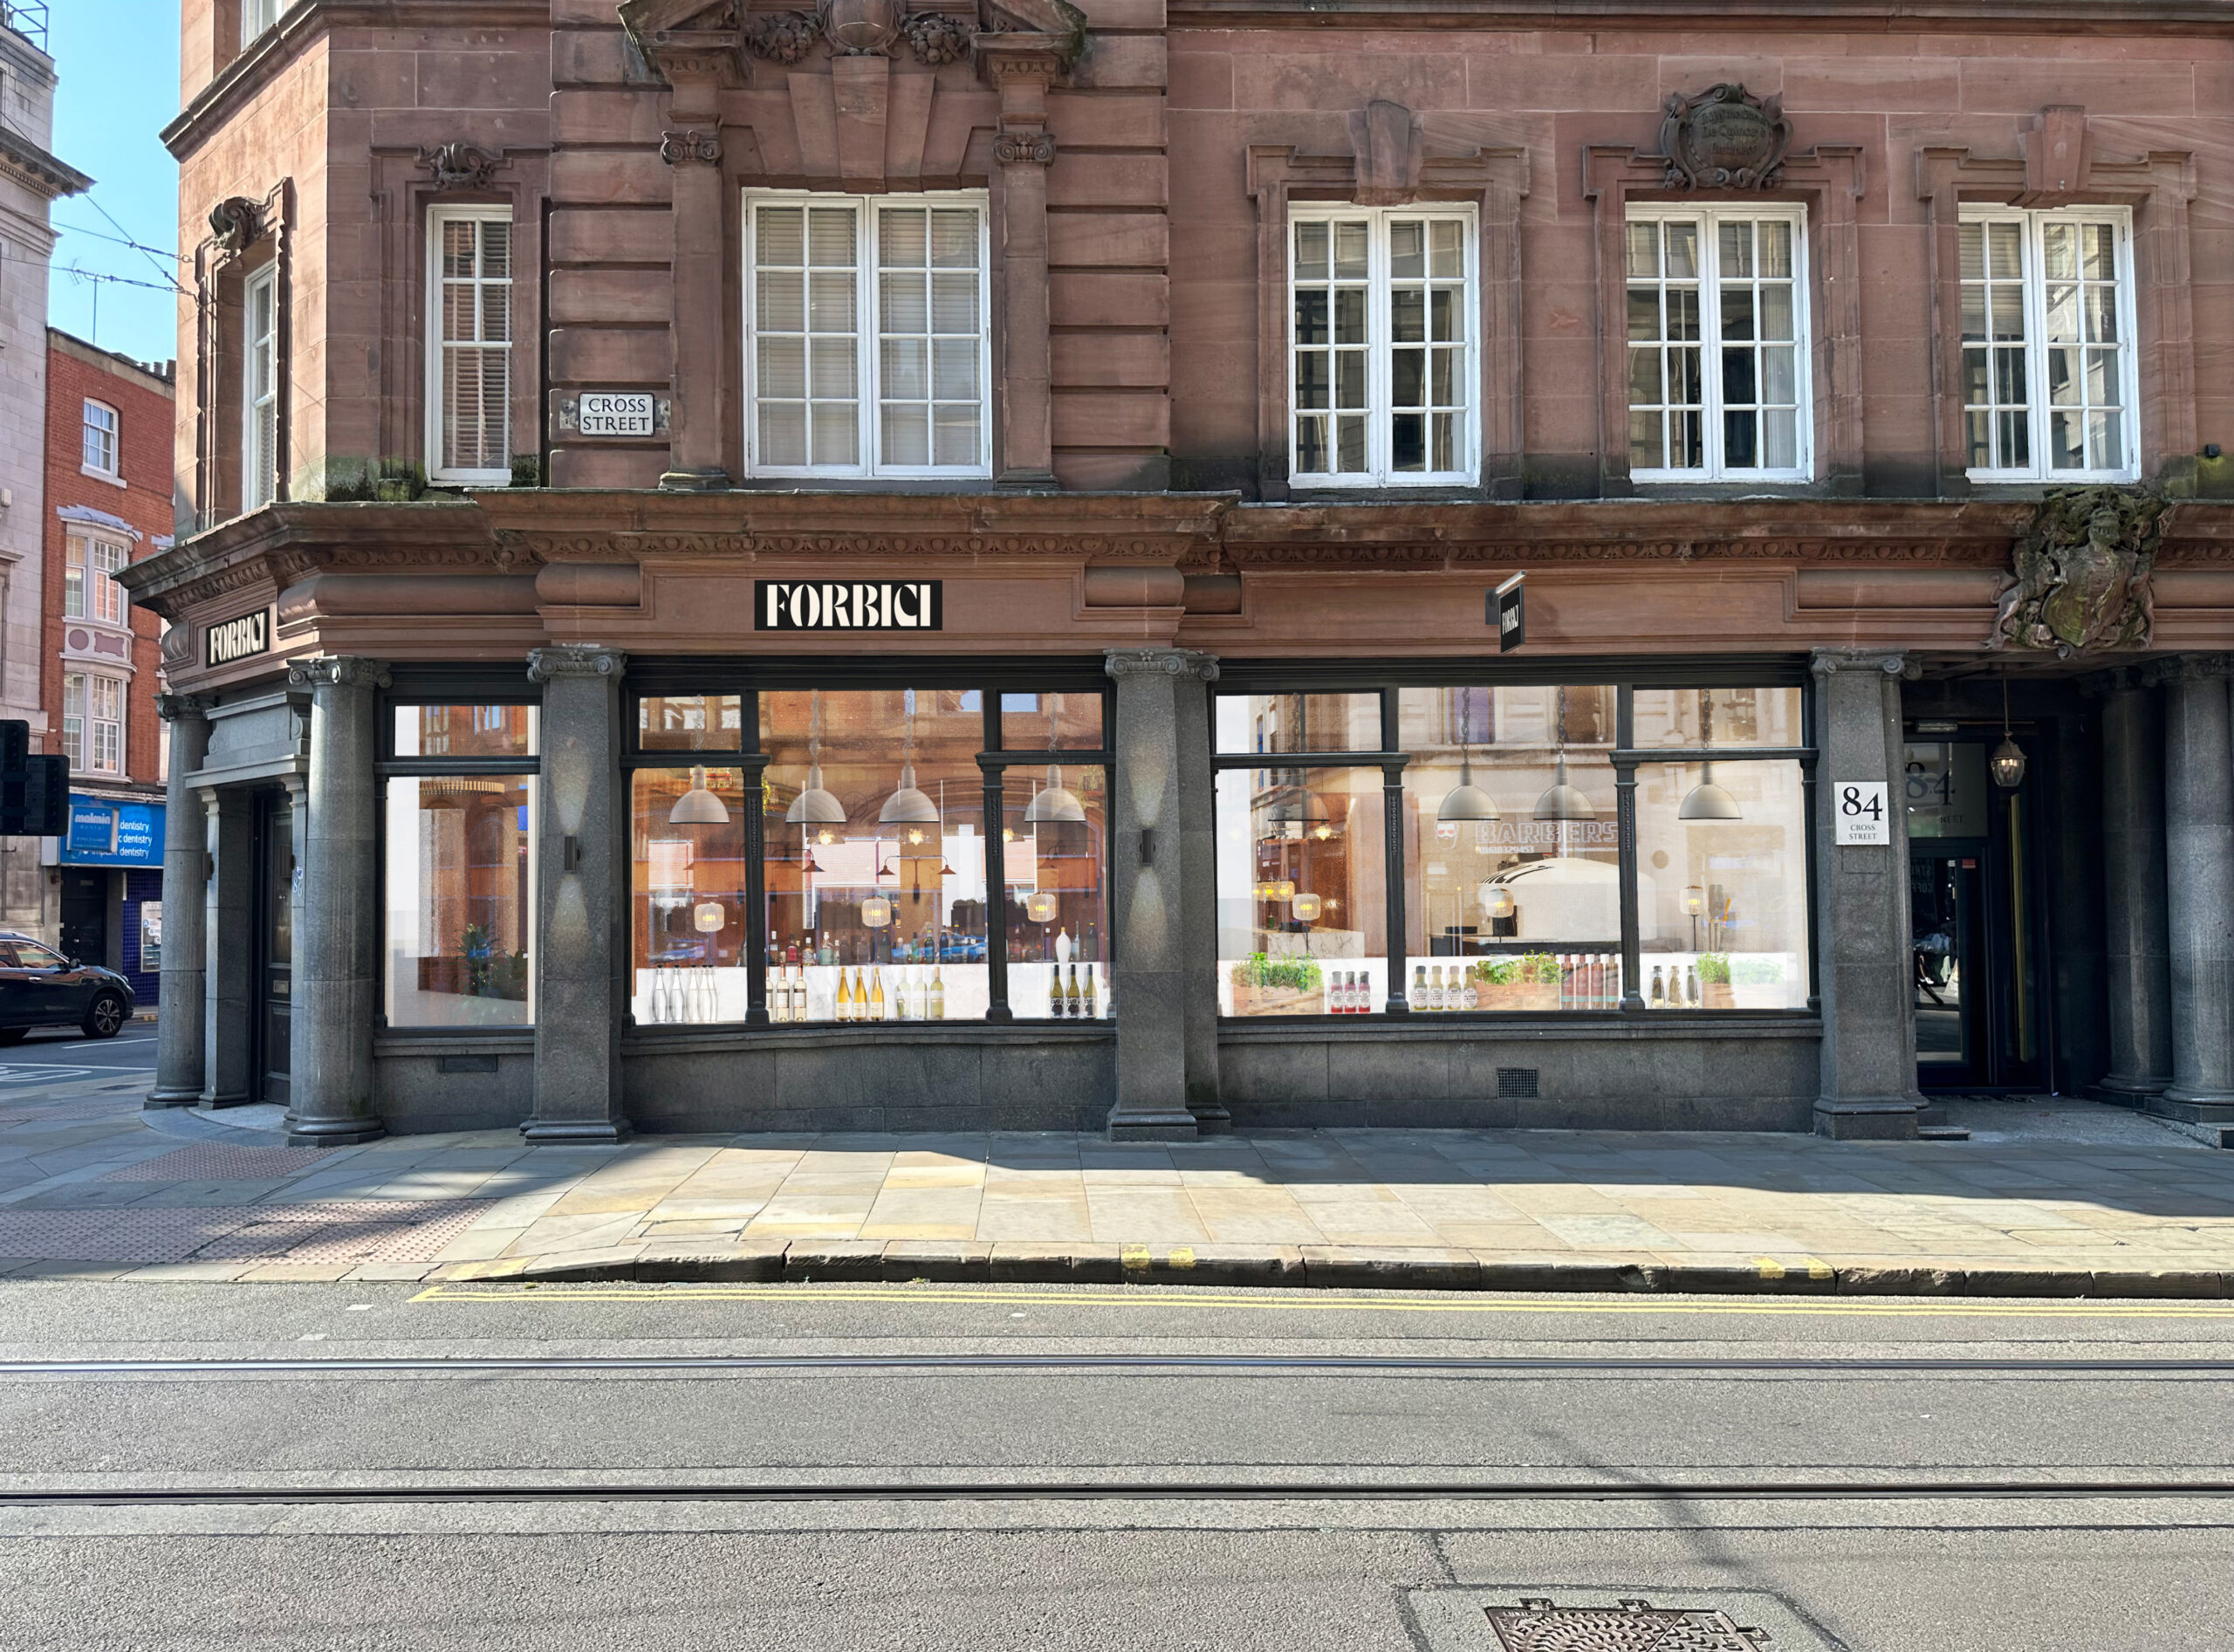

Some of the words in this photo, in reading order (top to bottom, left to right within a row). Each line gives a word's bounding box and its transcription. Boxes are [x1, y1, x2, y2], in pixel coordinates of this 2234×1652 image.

[588, 398, 646, 413] CROSS
[583, 416, 649, 431] STREET
[767, 584, 931, 627] FORBICI
[210, 612, 265, 664] FORBICI
[1842, 786, 1883, 821] 84
[120, 819, 149, 833] dentistry
[1475, 822, 1618, 843] BARBERS
[123, 834, 153, 847] dentistry
[120, 847, 149, 859] dentistry
